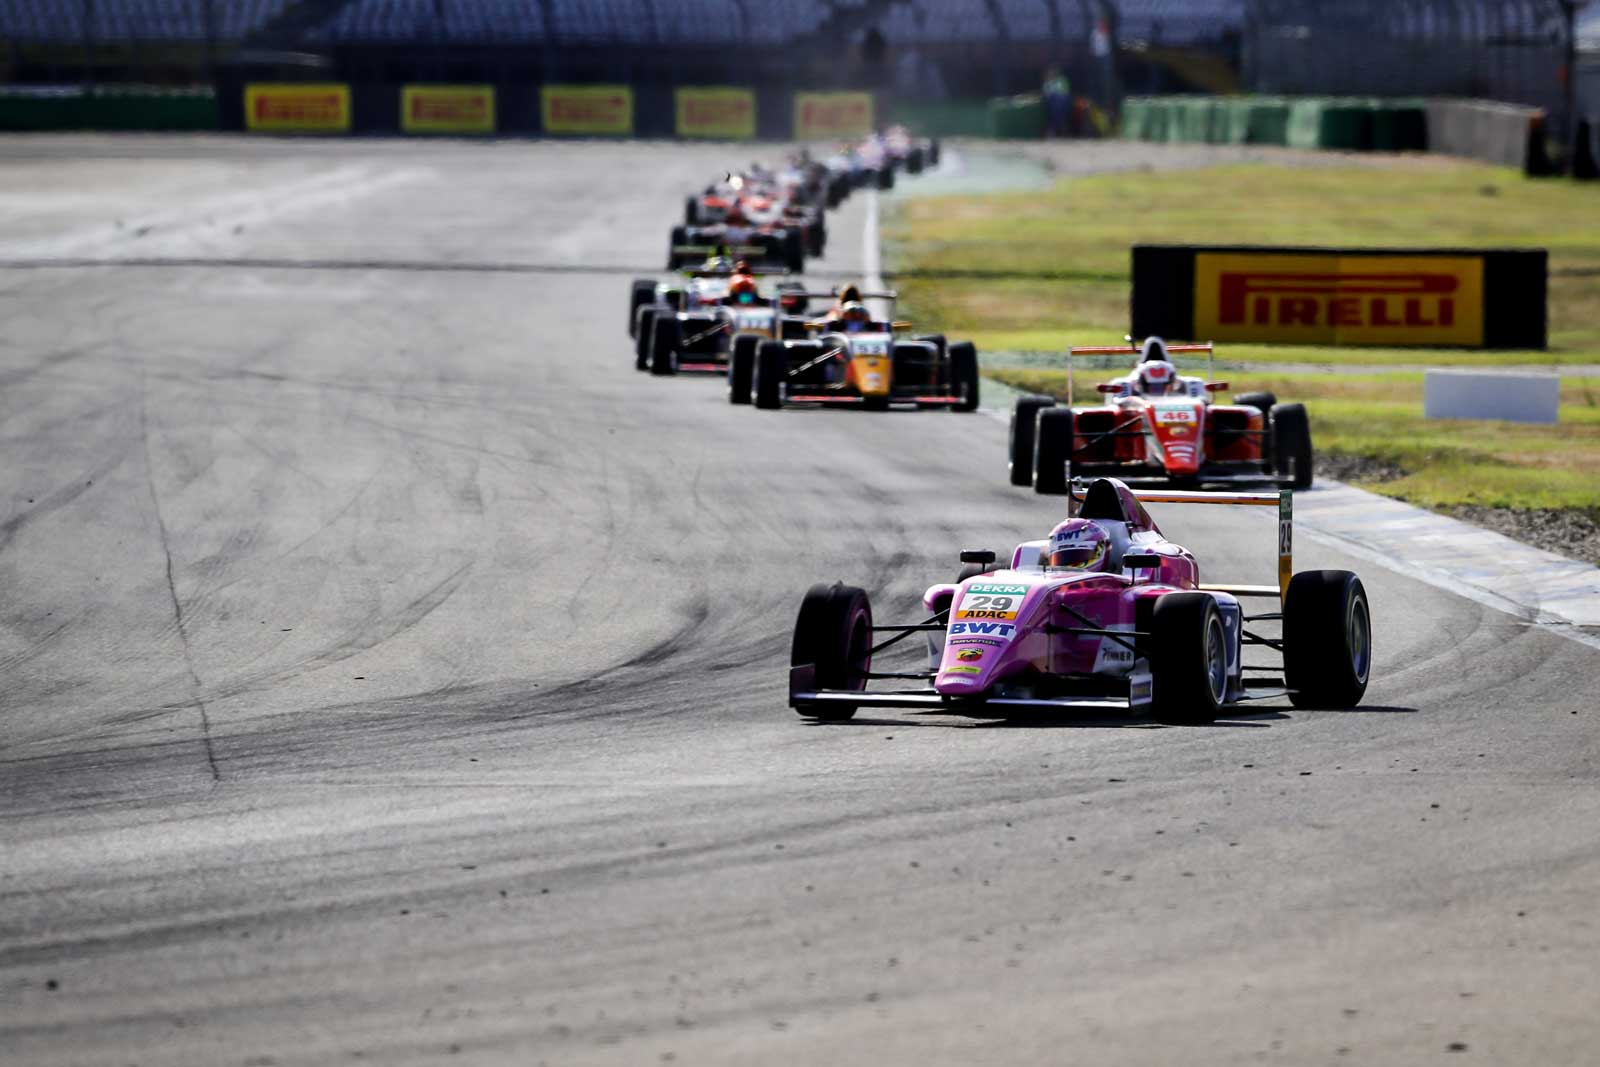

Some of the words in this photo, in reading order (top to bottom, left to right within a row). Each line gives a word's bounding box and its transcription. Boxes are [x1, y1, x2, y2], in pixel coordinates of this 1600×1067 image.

[1218, 272, 1460, 328] PIRELLI
[1163, 411, 1190, 421] 46
[1056, 530, 1081, 541] BWT
[969, 584, 1027, 593] DEKRA
[967, 595, 1014, 611] 29
[964, 610, 1008, 619] ADAC
[949, 622, 1016, 636] BWT
